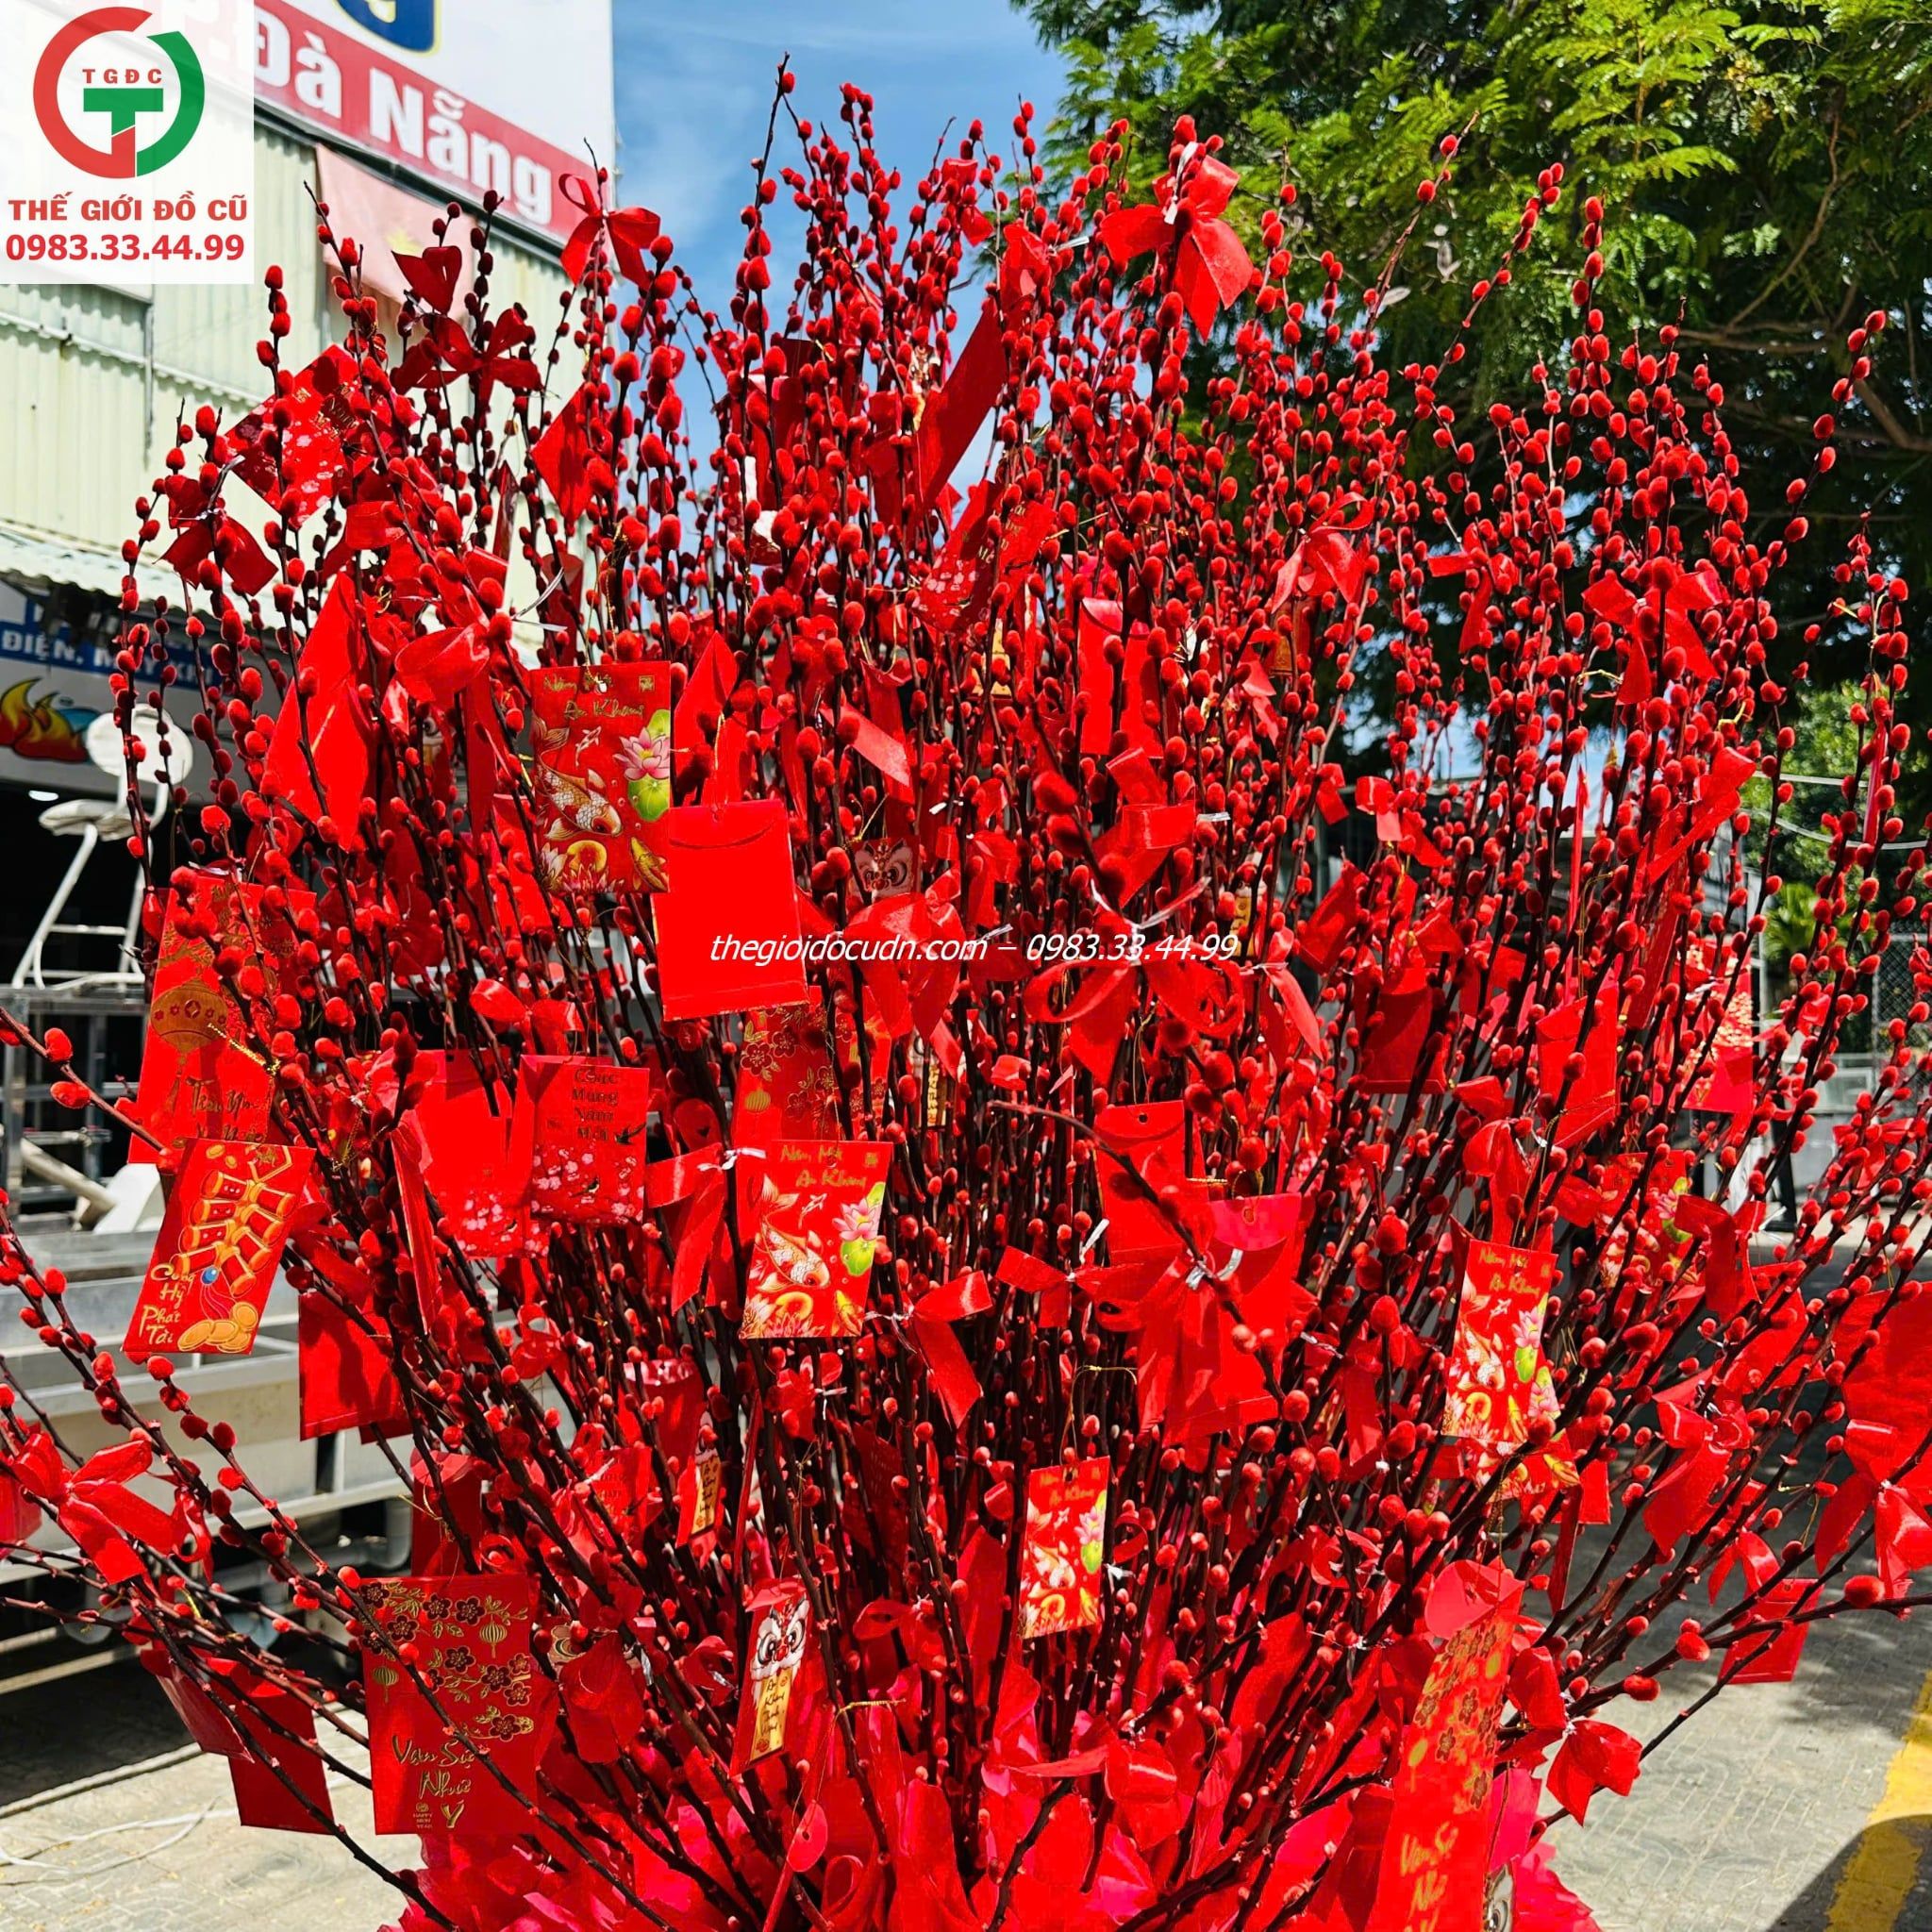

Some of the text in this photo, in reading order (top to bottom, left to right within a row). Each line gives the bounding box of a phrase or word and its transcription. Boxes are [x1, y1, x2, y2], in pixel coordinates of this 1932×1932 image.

[369, 67, 551, 225] Nẵng
[94, 648, 159, 676] MY
[139, 1305, 181, 1338] Phát
[145, 1324, 174, 1345] Tài
[440, 1799, 465, 1829] Ý
